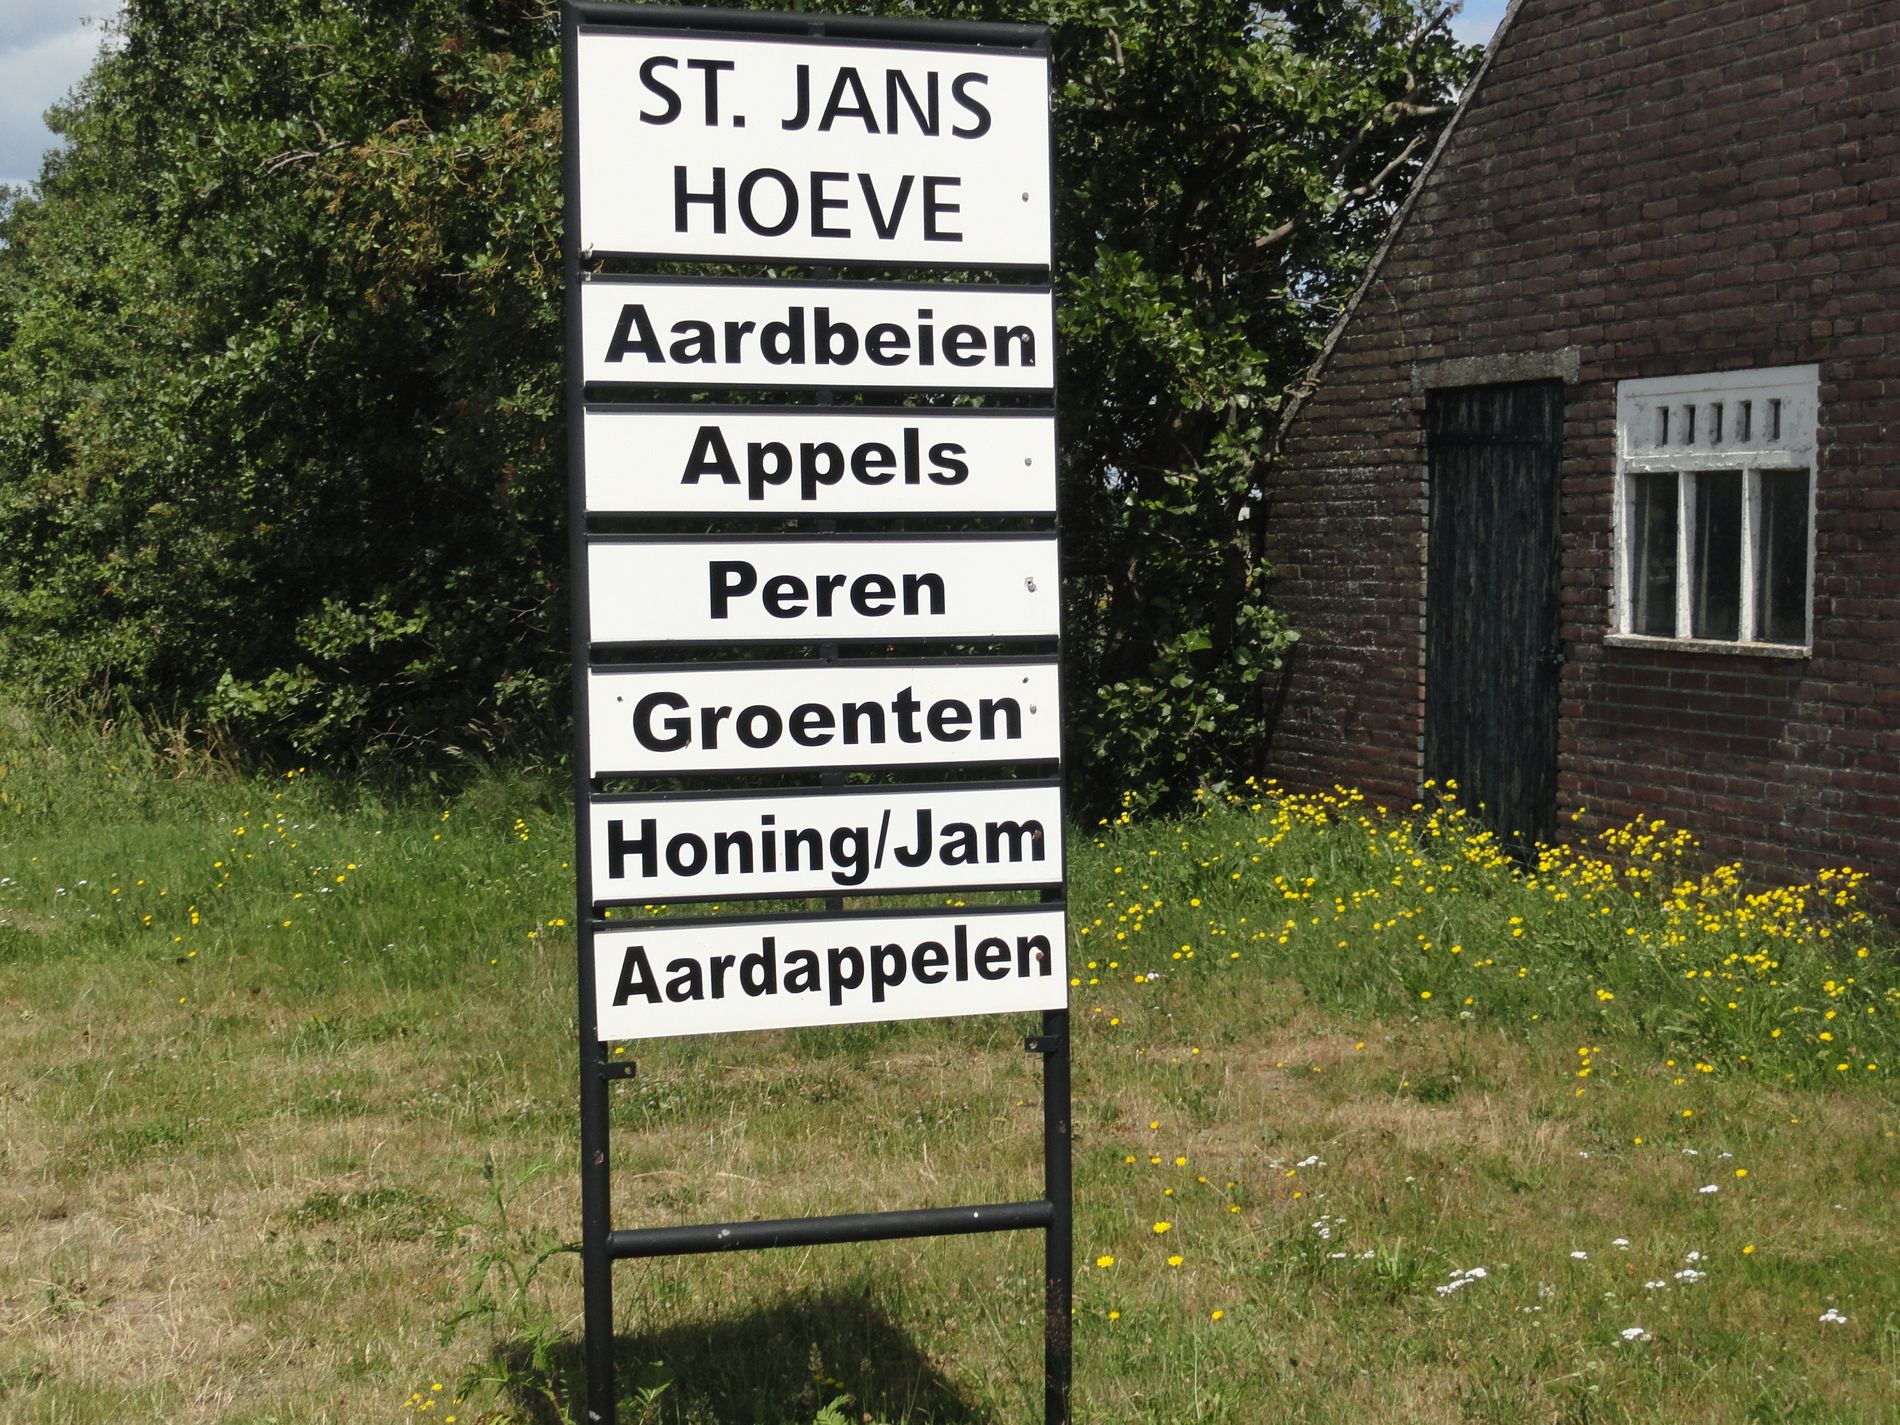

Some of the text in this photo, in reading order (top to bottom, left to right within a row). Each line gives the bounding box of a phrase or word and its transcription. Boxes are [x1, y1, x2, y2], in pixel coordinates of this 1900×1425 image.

[640, 56, 992, 140] ST. JANS
[675, 166, 963, 242] HOEVE
[605, 304, 1036, 367] Aardbeien
[681, 426, 969, 501] Appels
[710, 561, 946, 620] Peren
[633, 687, 1022, 753] Groenten
[608, 809, 1045, 886] Honing/Jam
[613, 925, 1052, 1007] Aardappelen
